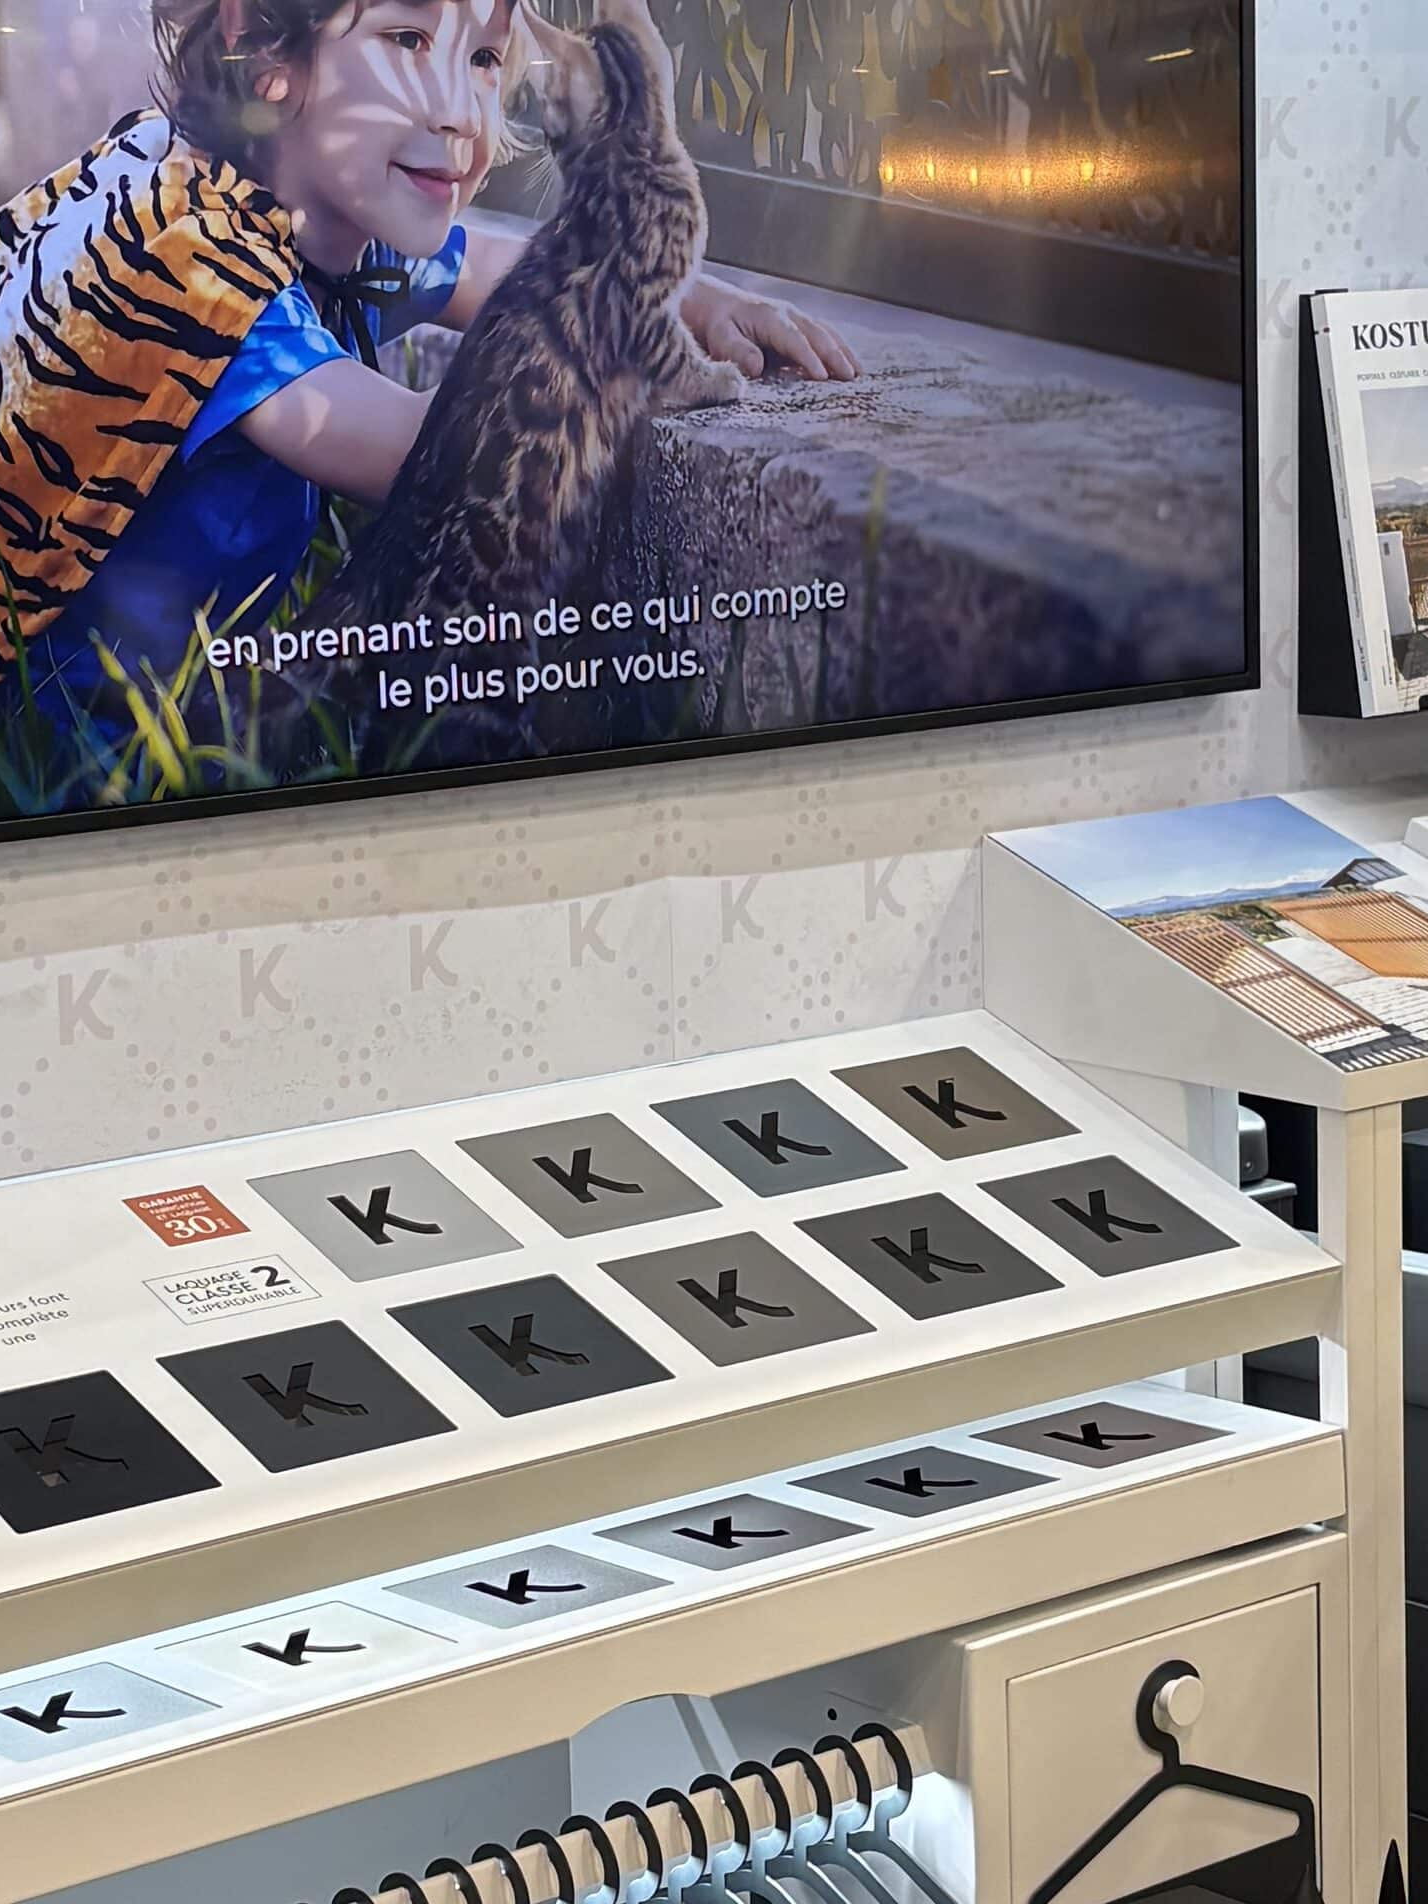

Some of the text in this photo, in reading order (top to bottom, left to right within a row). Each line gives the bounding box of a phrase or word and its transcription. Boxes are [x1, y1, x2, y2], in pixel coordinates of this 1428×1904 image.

[1258, 97, 1298, 160] K
[1384, 96, 1420, 158] K
[1258, 278, 1293, 341] K
[206, 577, 847, 673] en prenant soin de ce qui compte
[379, 649, 706, 714] le plus pour vous.
[58, 968, 114, 1045] K
[240, 944, 293, 1017] K
[409, 920, 459, 990] K
[569, 897, 616, 968] K
[721, 874, 764, 944] K
[863, 853, 906, 922] K
[328, 1076, 1009, 1247] K K K K
[139, 1192, 201, 1210] GARANTIE
[165, 1215, 217, 1239] 30
[28, 1291, 70, 1311] font
[163, 1270, 246, 1294] LAQUAGE
[175, 1265, 291, 1305] CLASSE 2
[187, 1286, 301, 1316] SUPERDURABLE
[241, 1362, 369, 1429] K
[467, 1311, 590, 1377] K
[677, 1267, 796, 1331] K
[870, 1225, 988, 1286] K
[1051, 1188, 1165, 1244] K
[2, 1332, 37, 1346] une
[240, 1627, 366, 1666] K
[464, 1568, 586, 1606] K
[671, 1515, 789, 1550] K
[864, 1466, 978, 1498] K
[1044, 1420, 1155, 1451] K
